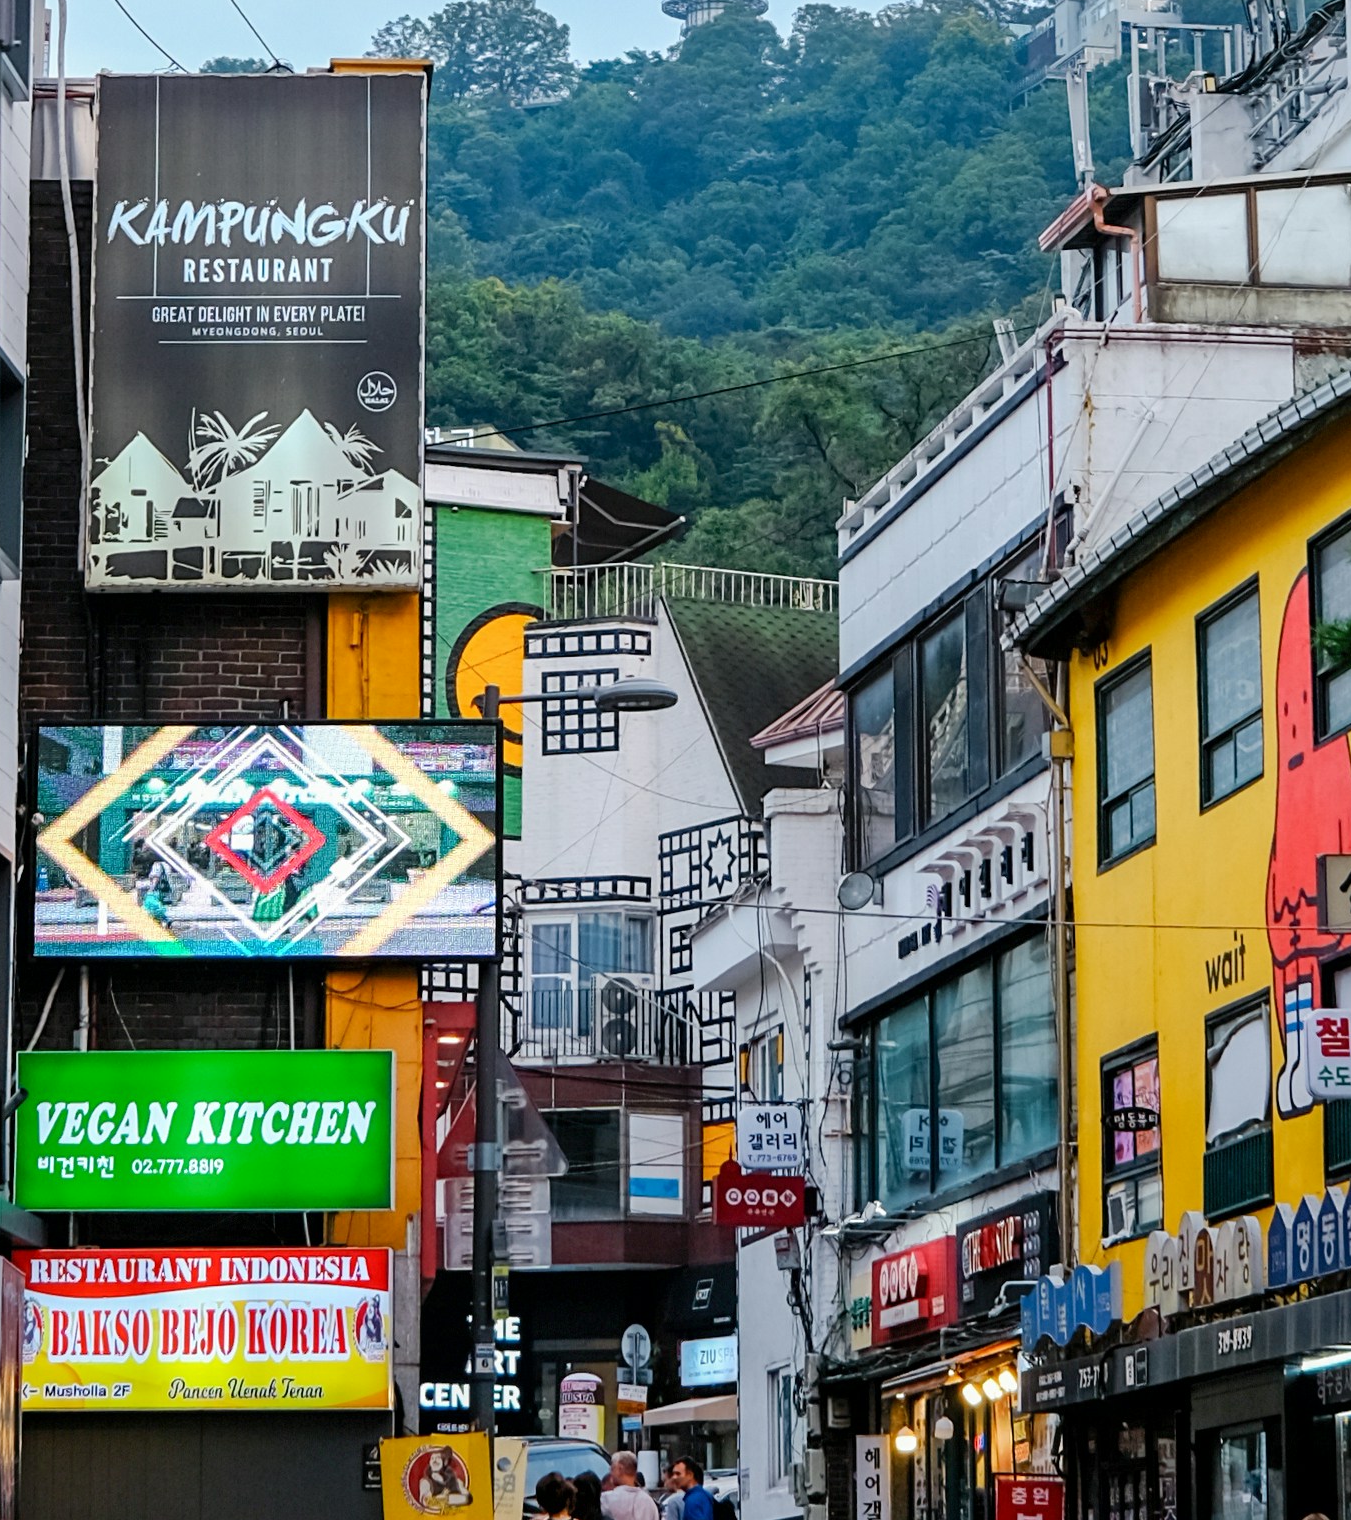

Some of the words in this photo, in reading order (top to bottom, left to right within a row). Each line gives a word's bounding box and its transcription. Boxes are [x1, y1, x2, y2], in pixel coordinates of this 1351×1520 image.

[107, 197, 414, 247] KAMPUNGKU
[183, 257, 334, 283] RESTAURANT
[151, 305, 195, 323] GREAT
[198, 305, 252, 323] DELIGHT
[255, 305, 270, 323] IN
[273, 305, 317, 323] EVERY
[191, 326, 281, 337] MYEONGDONG,
[285, 326, 324, 336] SEOUL
[1205, 930, 1246, 994] wait
[36, 1101, 178, 1145] VEGAN
[186, 1101, 376, 1145] KITCHEN
[756, 1111, 788, 1129] 헤어
[748, 1132, 798, 1151] 갤러리
[37, 1156, 115, 1179] 비건키친
[131, 1158, 225, 1175] 02.777.8819
[30, 1257, 211, 1283] RESTAURANT
[220, 1257, 369, 1282] INDONESIA
[1149, 1228, 1250, 1305] 우리집맛자랑
[51, 1309, 150, 1356] BAKSO
[161, 1309, 235, 1355] BEJO
[248, 1309, 348, 1355] KOREA
[45, 1385, 106, 1397] Musholla
[113, 1384, 130, 1397] 2F
[281, 1378, 324, 1398] Tenan
[419, 1383, 521, 1409] CENER
